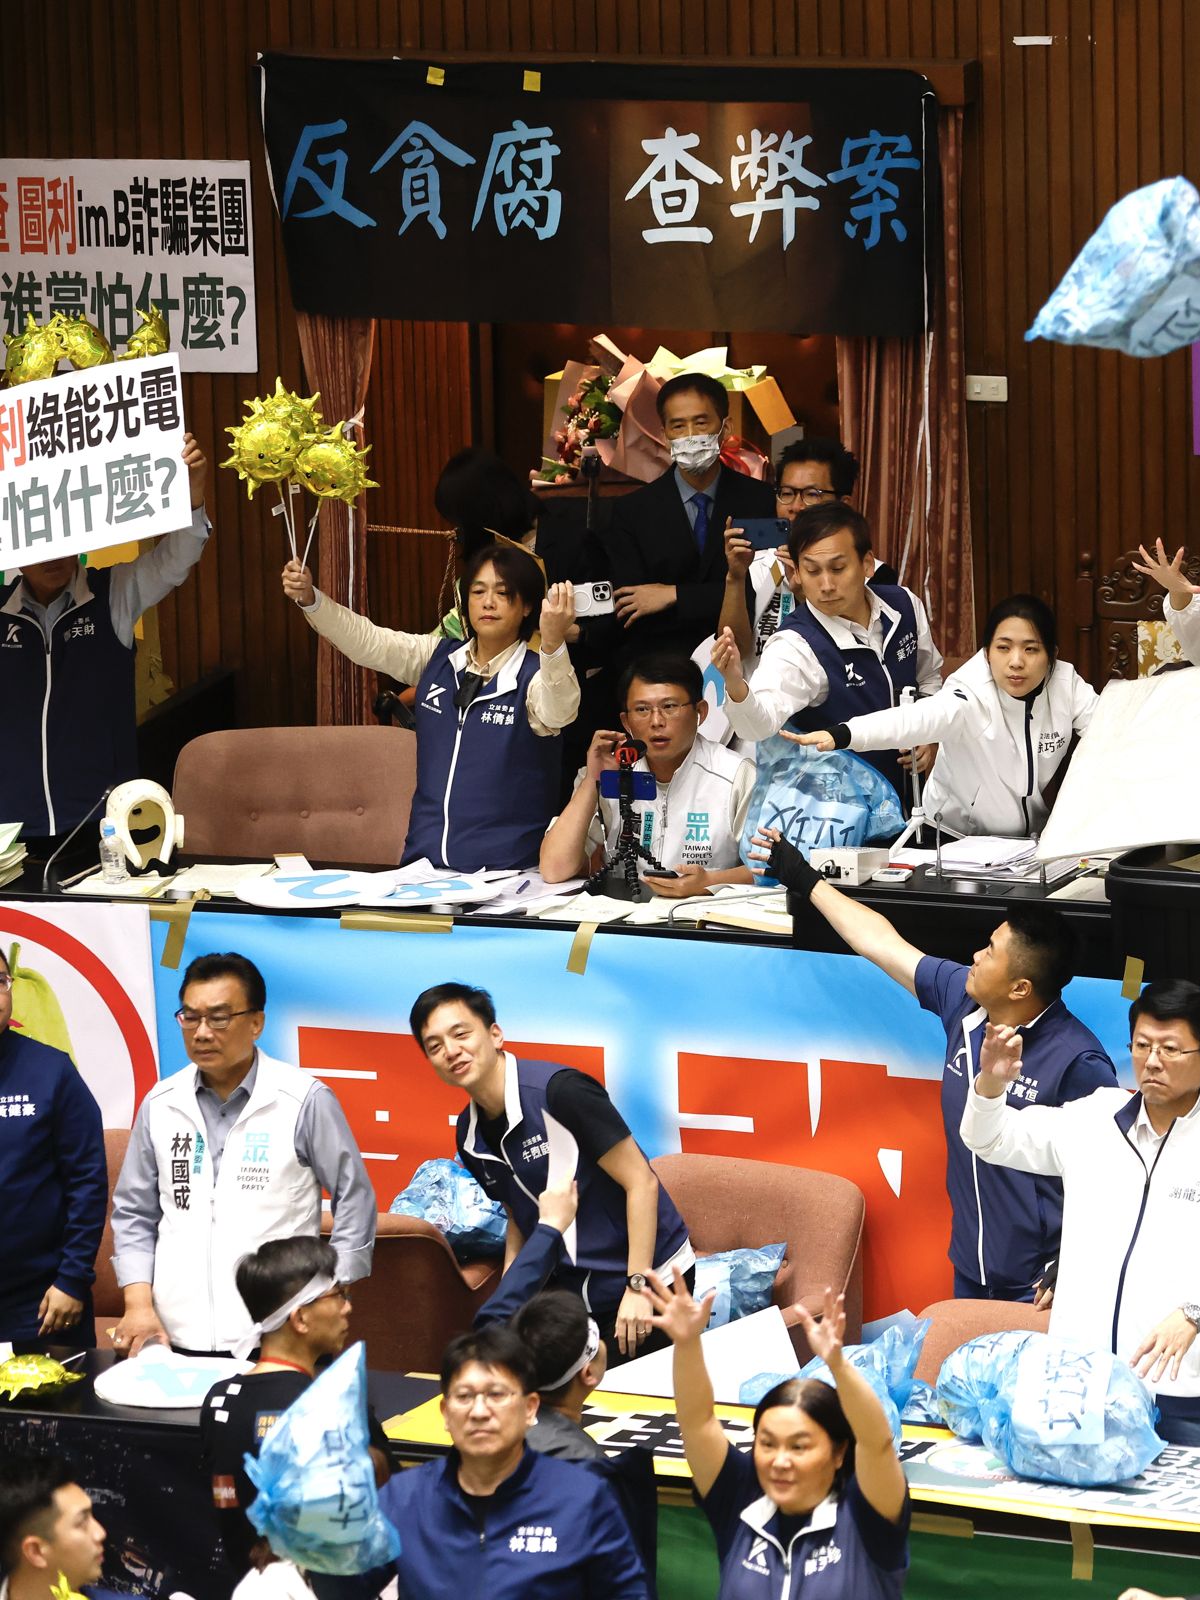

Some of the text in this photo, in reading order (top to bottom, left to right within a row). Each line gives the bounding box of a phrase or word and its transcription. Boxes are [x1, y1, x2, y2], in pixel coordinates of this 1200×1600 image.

[17, 176, 249, 257] 圖利im.B詐騙集團
[283, 118, 921, 252] 反貪腐 查弊案
[684, 844, 712, 852] TAIWAN
[171, 1132, 193, 1211] 林國成
